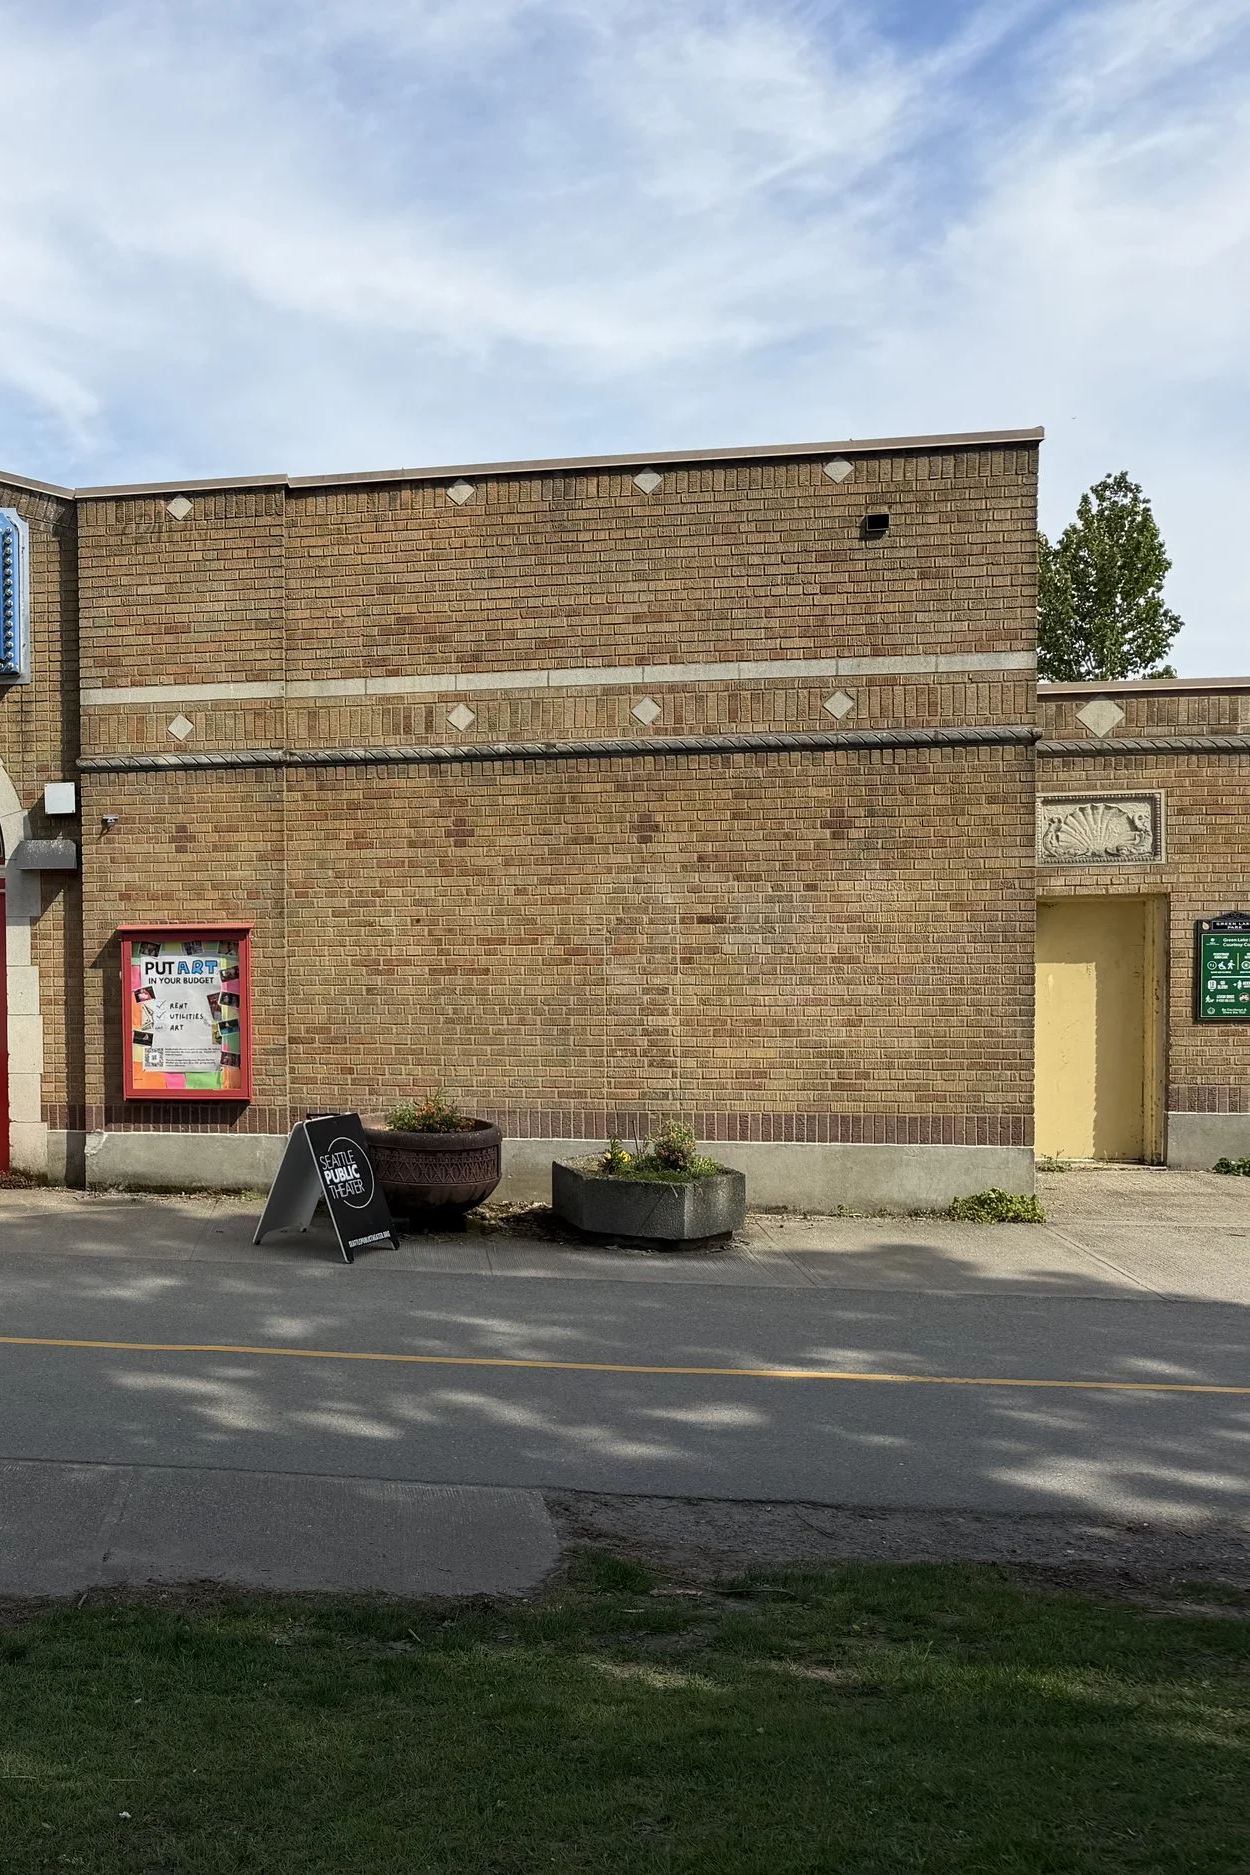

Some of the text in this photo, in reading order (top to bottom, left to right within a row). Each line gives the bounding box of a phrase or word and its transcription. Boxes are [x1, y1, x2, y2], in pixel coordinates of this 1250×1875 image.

[145, 960, 218, 975] PUT ART
[319, 1150, 356, 1170] SEATTLE
[323, 1164, 361, 1185] PUBLIC
[329, 1179, 366, 1199] THEATER
